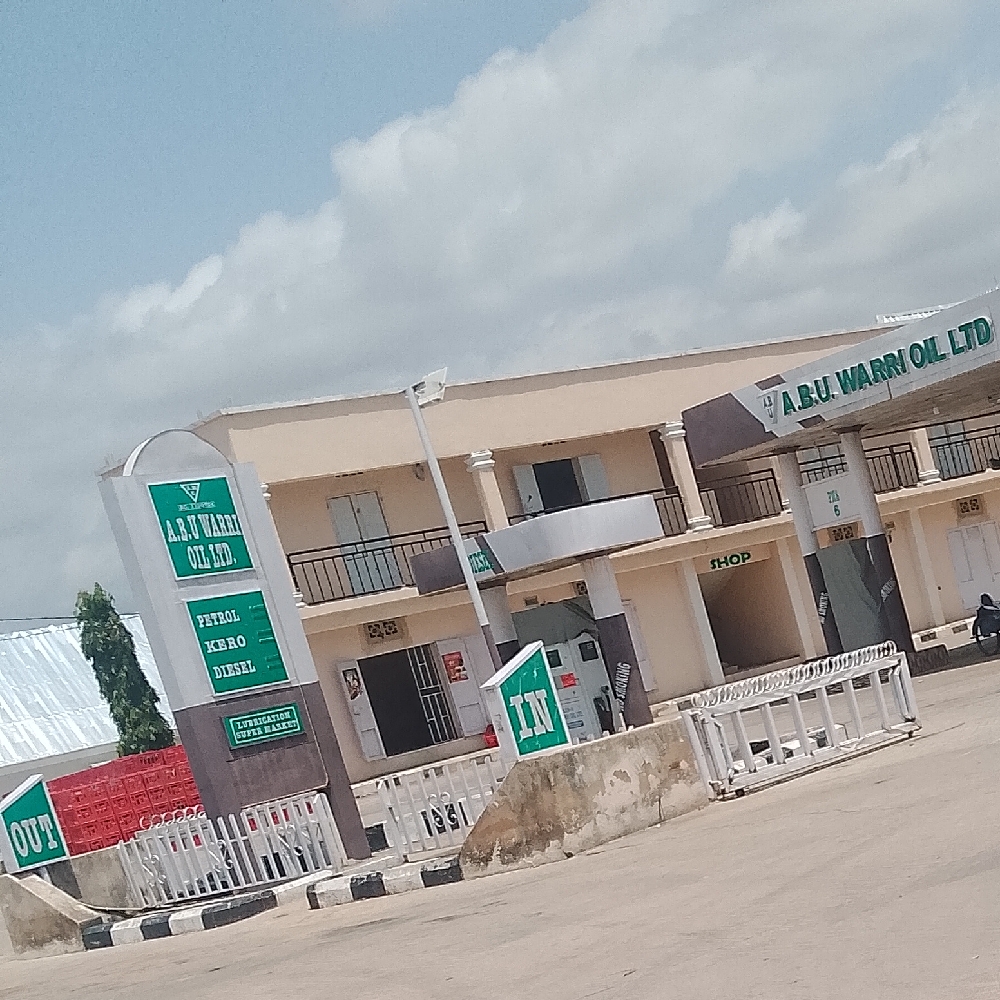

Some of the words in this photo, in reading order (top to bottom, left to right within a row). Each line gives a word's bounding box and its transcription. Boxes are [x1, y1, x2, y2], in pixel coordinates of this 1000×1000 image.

[835, 348, 909, 395] WARRI
[909, 335, 947, 369] OIL
[947, 316, 994, 356] LTD
[197, 513, 243, 538] WARRI
[187, 544, 211, 570] OIL
[710, 552, 751, 570] SHOP
[196, 609, 240, 628] PETROL
[204, 635, 247, 654] KERO
[212, 660, 256, 679] DIESEL
[615, 662, 632, 699] SMOKING
[236, 711, 291, 730] LUBRICATION
[509, 689, 556, 740] IN
[235, 726, 263, 740] SUPER
[264, 719, 297, 735] MARKET
[10, 813, 58, 857] OUT
